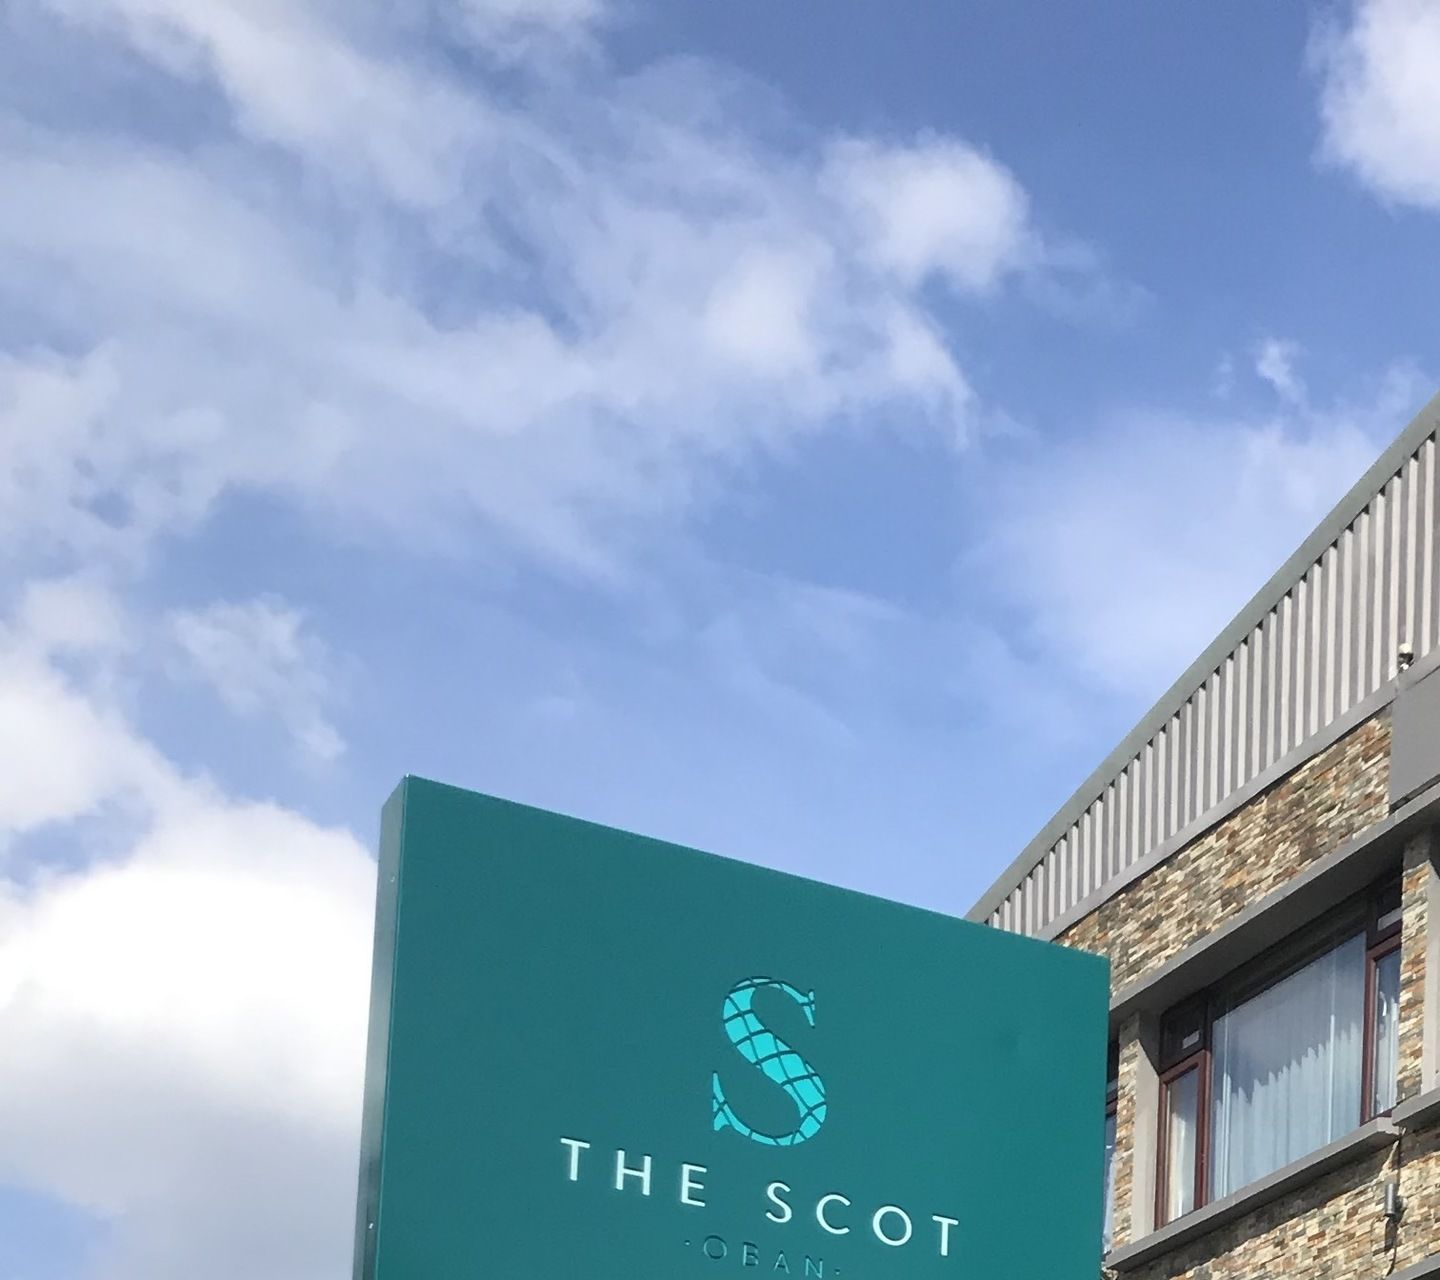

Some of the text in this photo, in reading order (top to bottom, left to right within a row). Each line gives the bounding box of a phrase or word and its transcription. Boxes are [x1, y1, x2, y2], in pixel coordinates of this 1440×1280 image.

[712, 975, 827, 1147] S
[559, 1137, 960, 1258] THE SCOT
